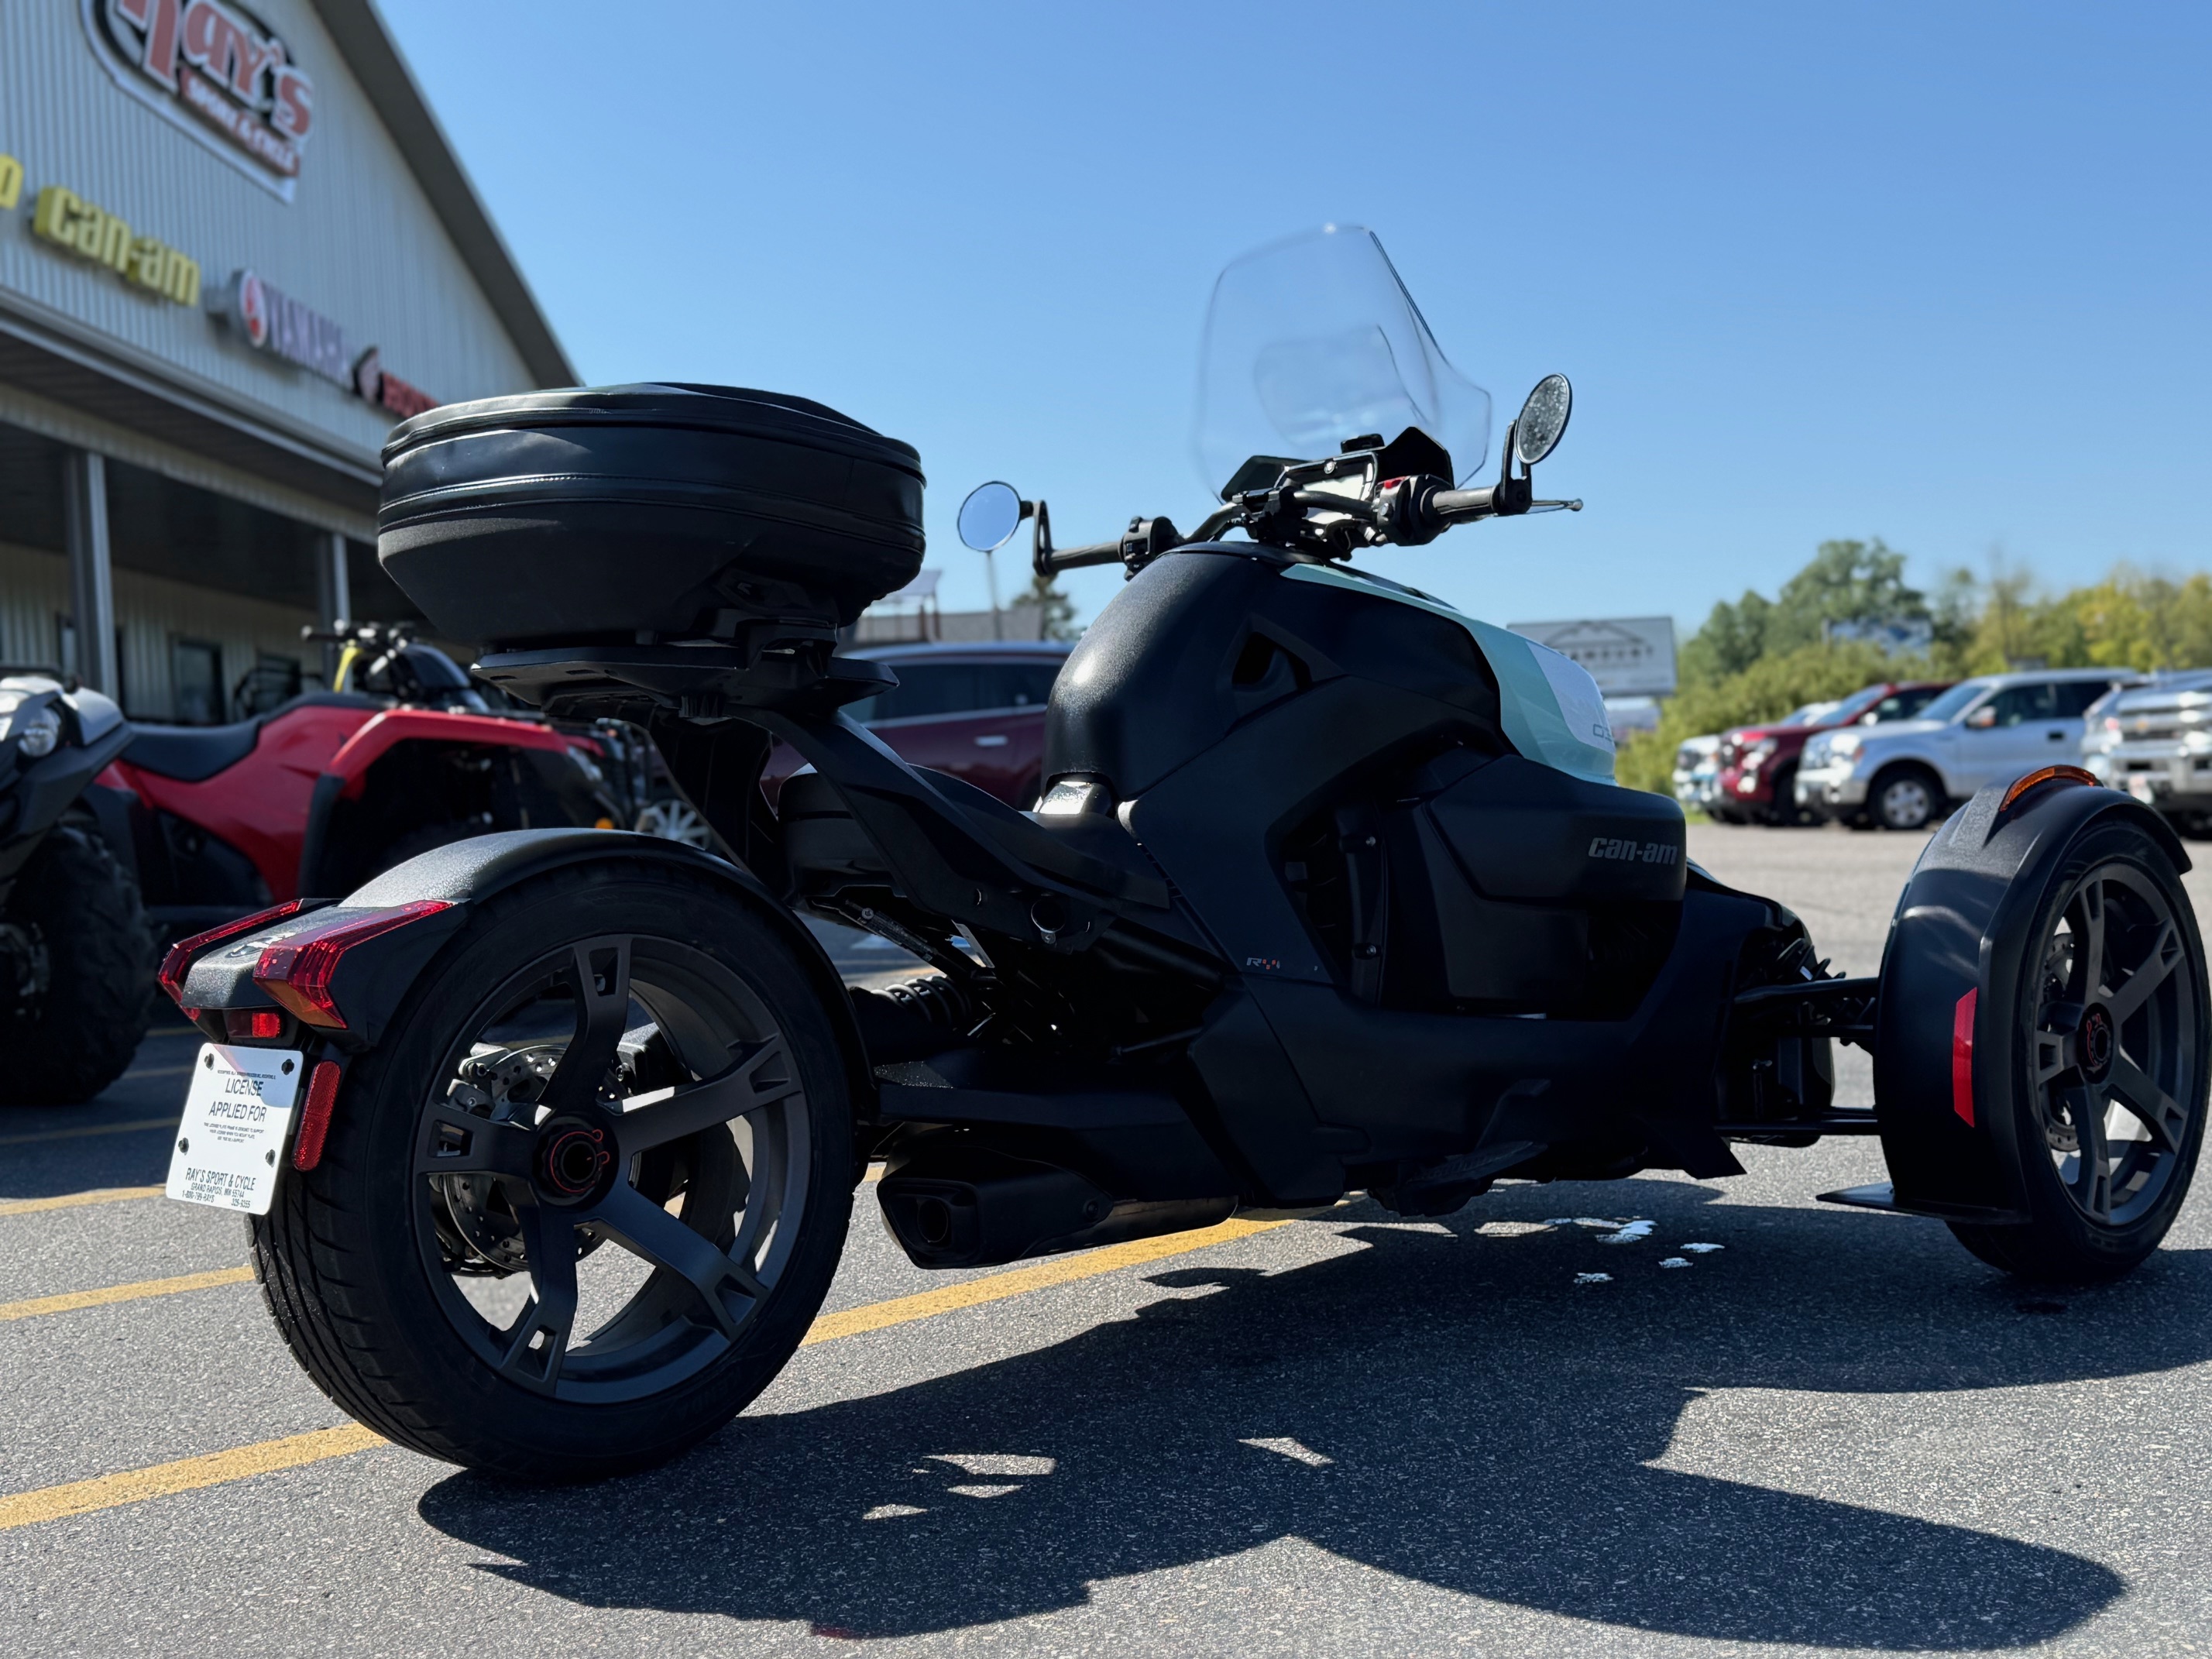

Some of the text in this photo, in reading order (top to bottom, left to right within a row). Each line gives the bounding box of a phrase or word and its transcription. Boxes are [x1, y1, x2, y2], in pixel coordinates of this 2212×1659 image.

[1588, 837, 1678, 865] can-am
[225, 1078, 264, 1097] LICENSE
[208, 1101, 267, 1122] APPLIED FOR
[186, 1167, 256, 1190] RAY'S SPORT & CYCLE
